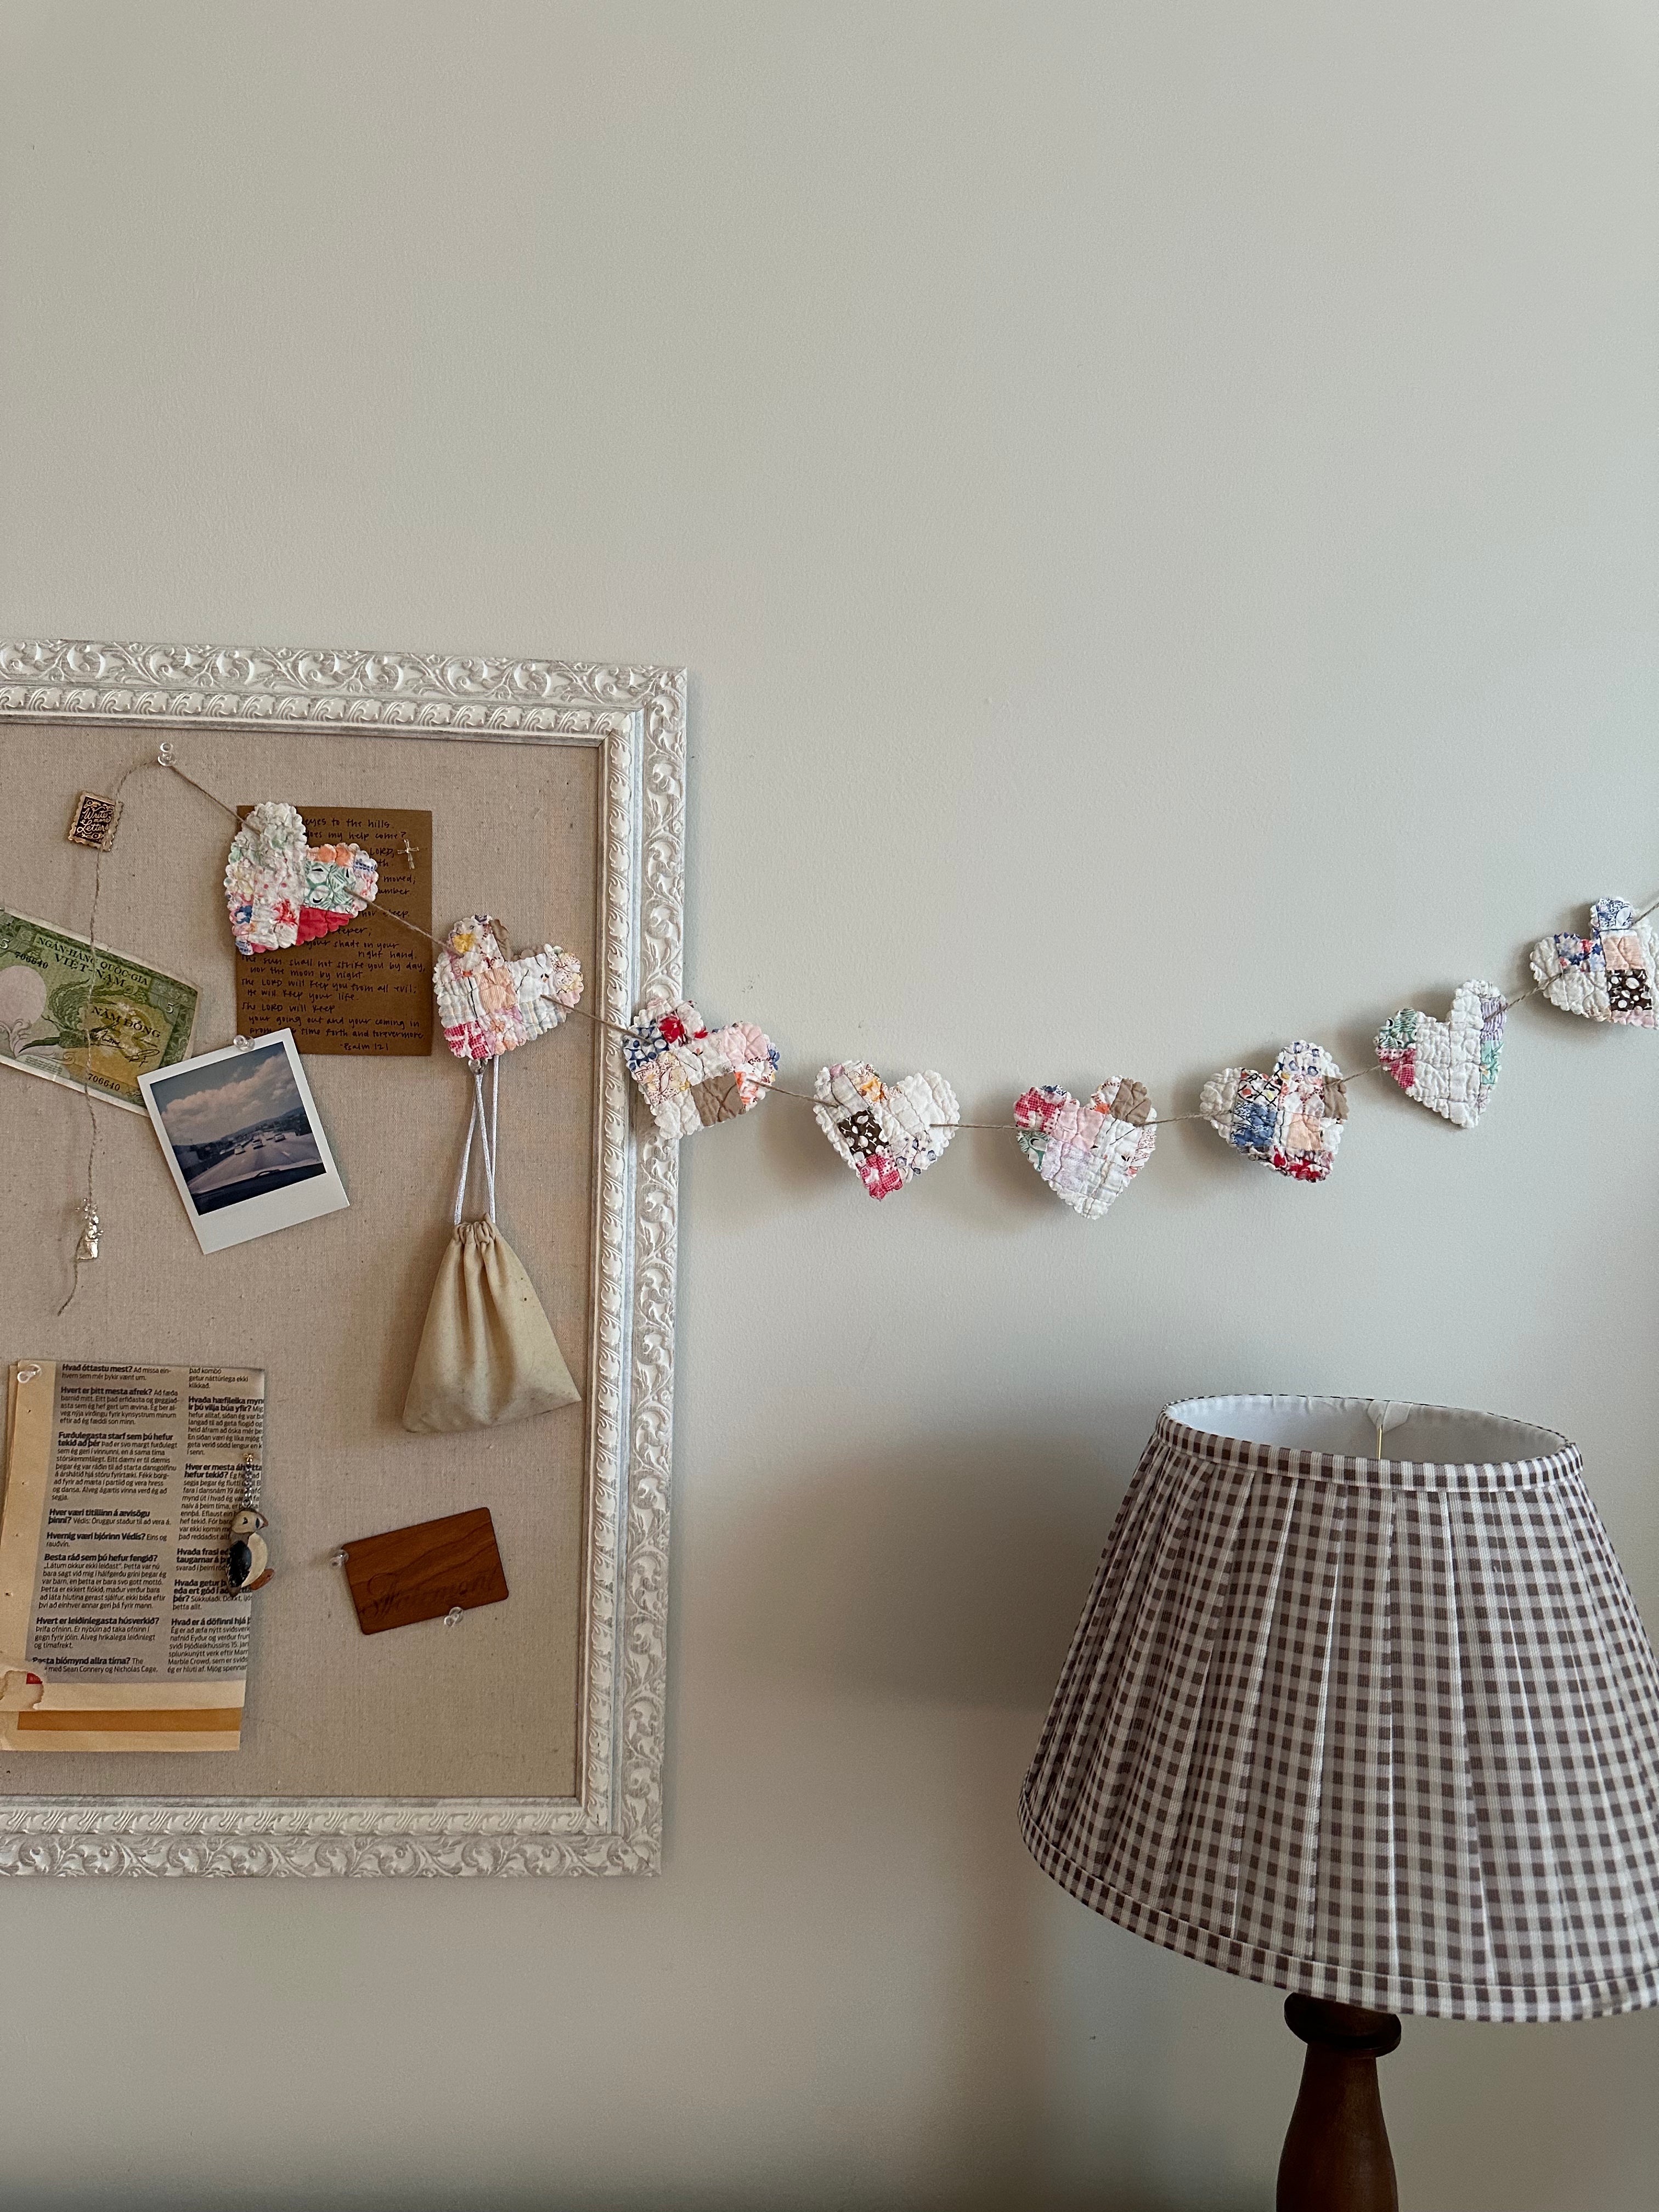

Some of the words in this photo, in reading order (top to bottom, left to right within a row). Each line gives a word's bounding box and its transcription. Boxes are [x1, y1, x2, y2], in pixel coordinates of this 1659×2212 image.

[82, 806, 112, 819] Write
[305, 818, 326, 827] eyes
[331, 817, 340, 826] to
[346, 819, 362, 827] the
[77, 820, 109, 834] Letters
[328, 832, 342, 840] my
[349, 831, 369, 840] help
[375, 832, 407, 840] come?
[370, 847, 394, 857] LORD,
[337, 927, 371, 936] eeper;
[0, 938, 10, 949] 5
[306, 940, 330, 950] your
[334, 940, 359, 948] shade
[377, 943, 399, 952] your
[358, 950, 383, 959] right
[337, 961, 364, 969] strike
[368, 962, 383, 972] you
[390, 962, 400, 972] by
[406, 962, 425, 972] day,
[320, 971, 331, 980] by
[262, 979, 283, 987] LORD
[310, 980, 329, 991] keep
[332, 983, 347, 991] you
[351, 983, 373, 992] from
[377, 984, 388, 993] all
[283, 989, 303, 1000] keep
[309, 992, 332, 1003] your
[166, 1002, 174, 1014] 5
[242, 1002, 256, 1010] The
[262, 1003, 283, 1012] LORD
[289, 1004, 306, 1012] will
[312, 1005, 335, 1014] keep
[249, 1016, 270, 1024] your
[276, 1016, 302, 1026] going
[348, 1018, 371, 1029] your
[375, 1019, 405, 1030] coming
[410, 1018, 420, 1027] in
[326, 1029, 348, 1037] forth
[88, 1073, 120, 1091] 706640
[58, 1432, 106, 1441] Furðulegasta
[143, 1432, 152, 1441] þú
[119, 1510, 150, 1518] ævisögu
[48, 1516, 71, 1525] þinni?
[47, 1532, 76, 1541] Hvernig
[94, 1532, 120, 1541] bjórinn
[98, 1554, 108, 1562] þú
[130, 1554, 158, 1563] fengið?
[201, 1587, 215, 1595] góð
[173, 1595, 190, 1604] þér?
[68, 1617, 117, 1626] leiðinlegasta
[55, 1657, 89, 1666] bíómynd
